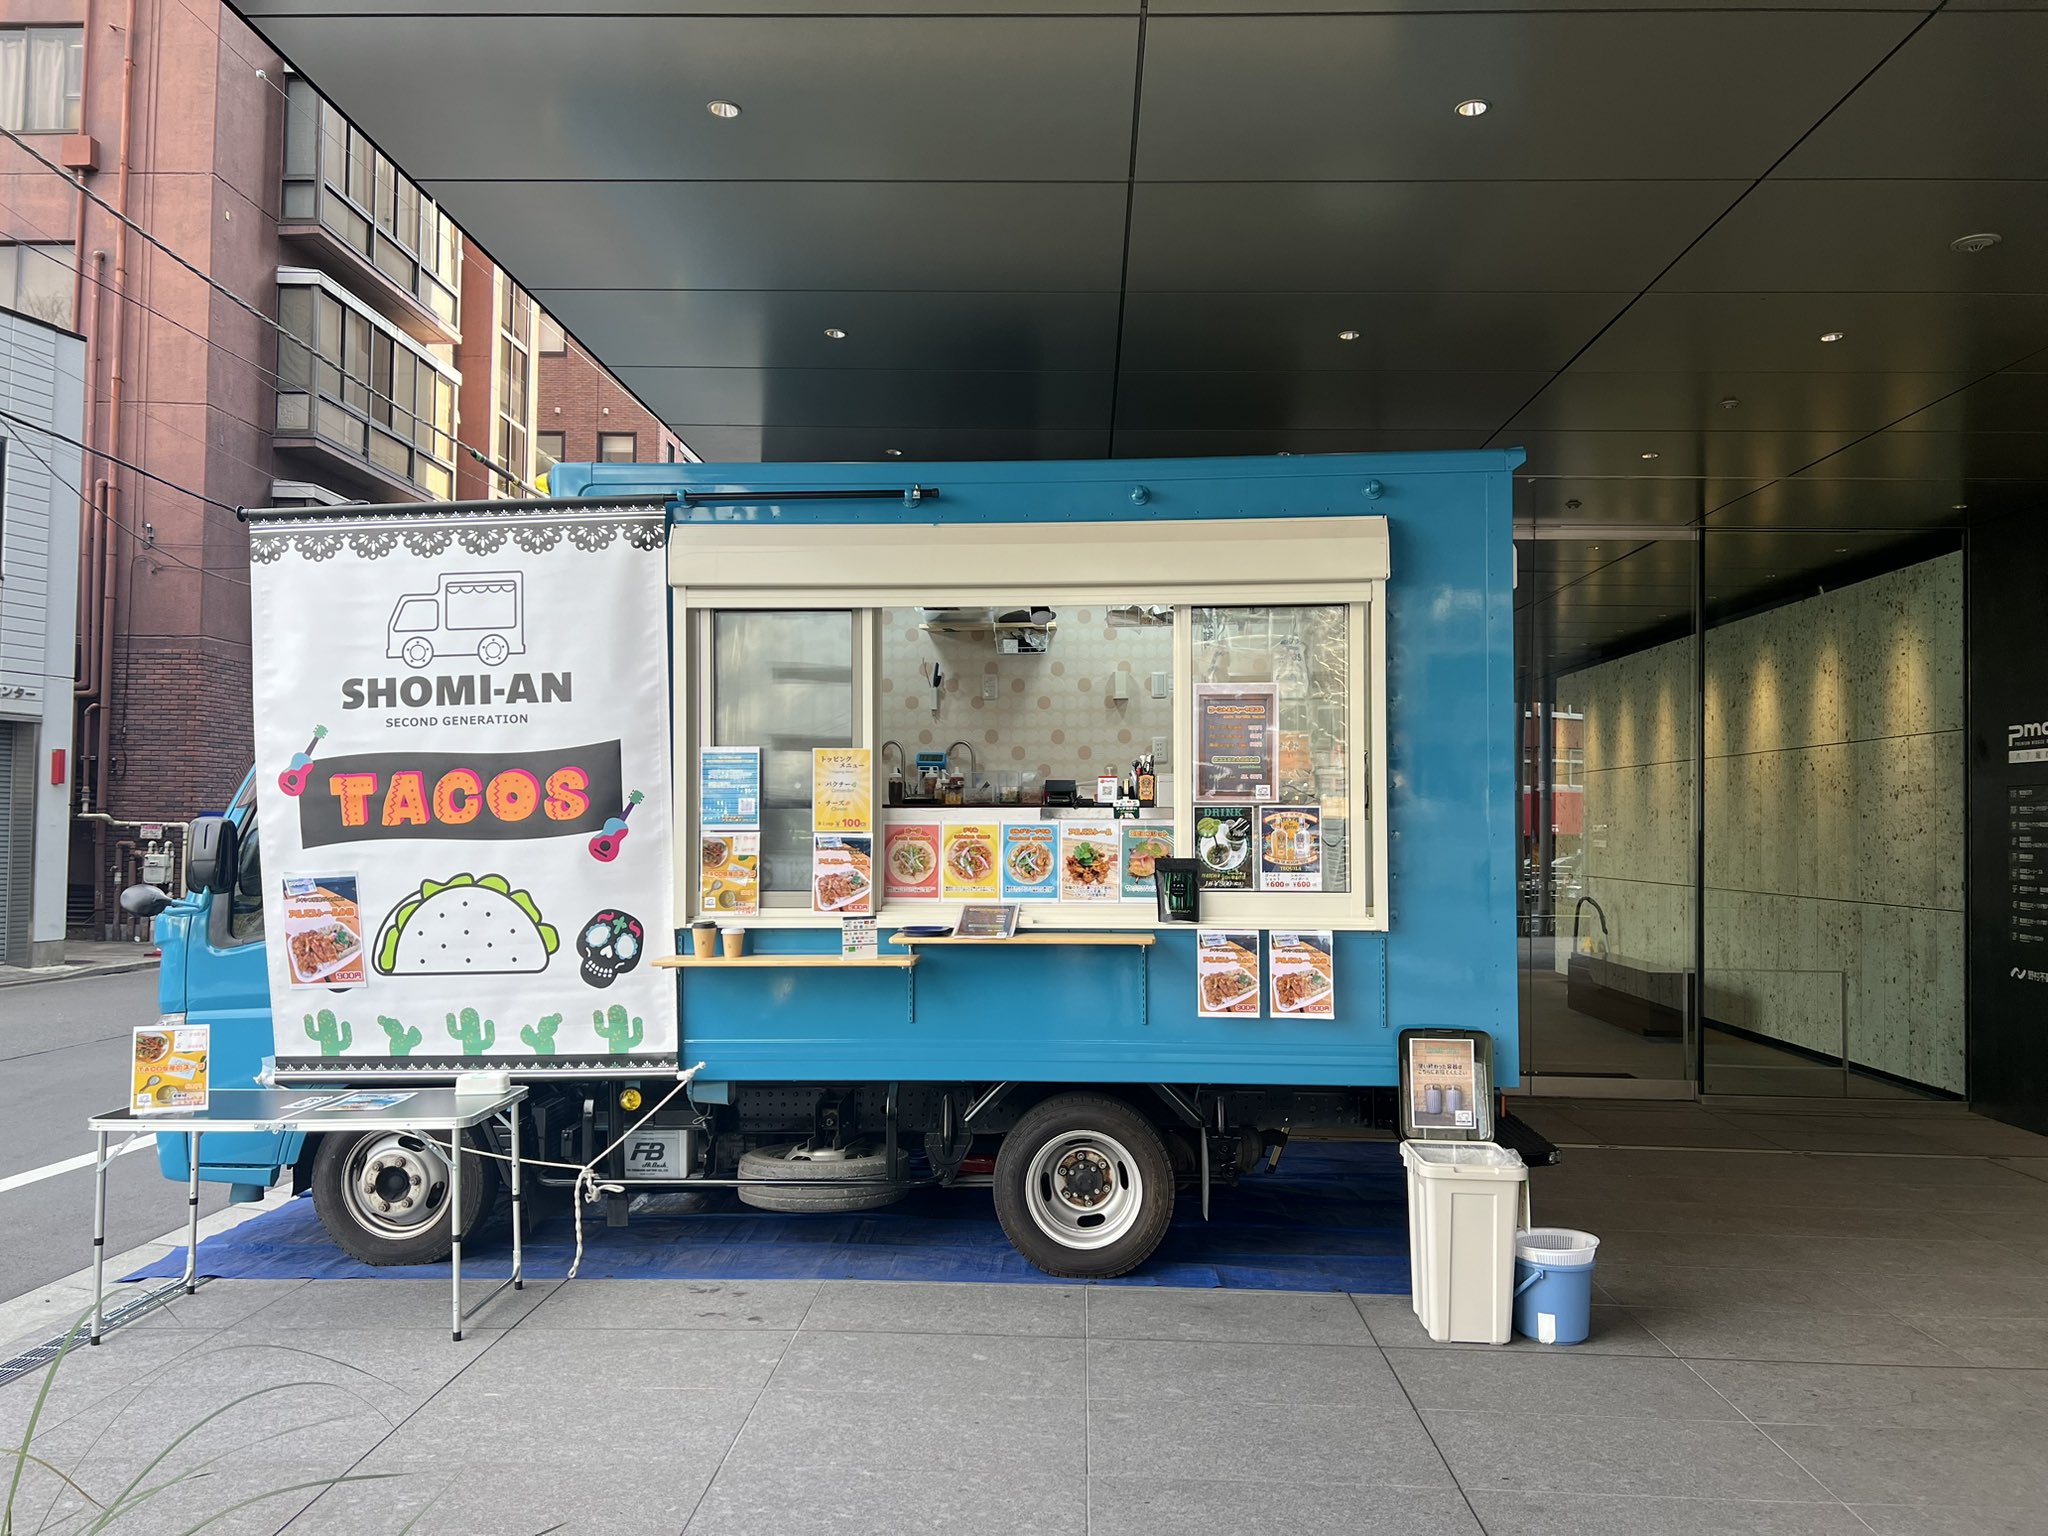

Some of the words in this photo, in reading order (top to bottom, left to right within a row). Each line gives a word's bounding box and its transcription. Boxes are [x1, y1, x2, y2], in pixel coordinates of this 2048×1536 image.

[0, 686, 36, 699] ンター
[342, 671, 572, 710] SHOMI-AN
[385, 715, 438, 728] SECOND
[442, 713, 529, 726] GENERATION
[328, 766, 590, 827] TACOS
[1203, 808, 1243, 817] DRINK
[336, 971, 362, 980] 900円
[2027, 970, 2048, 982] 野村不
[630, 1142, 666, 1161] FB
